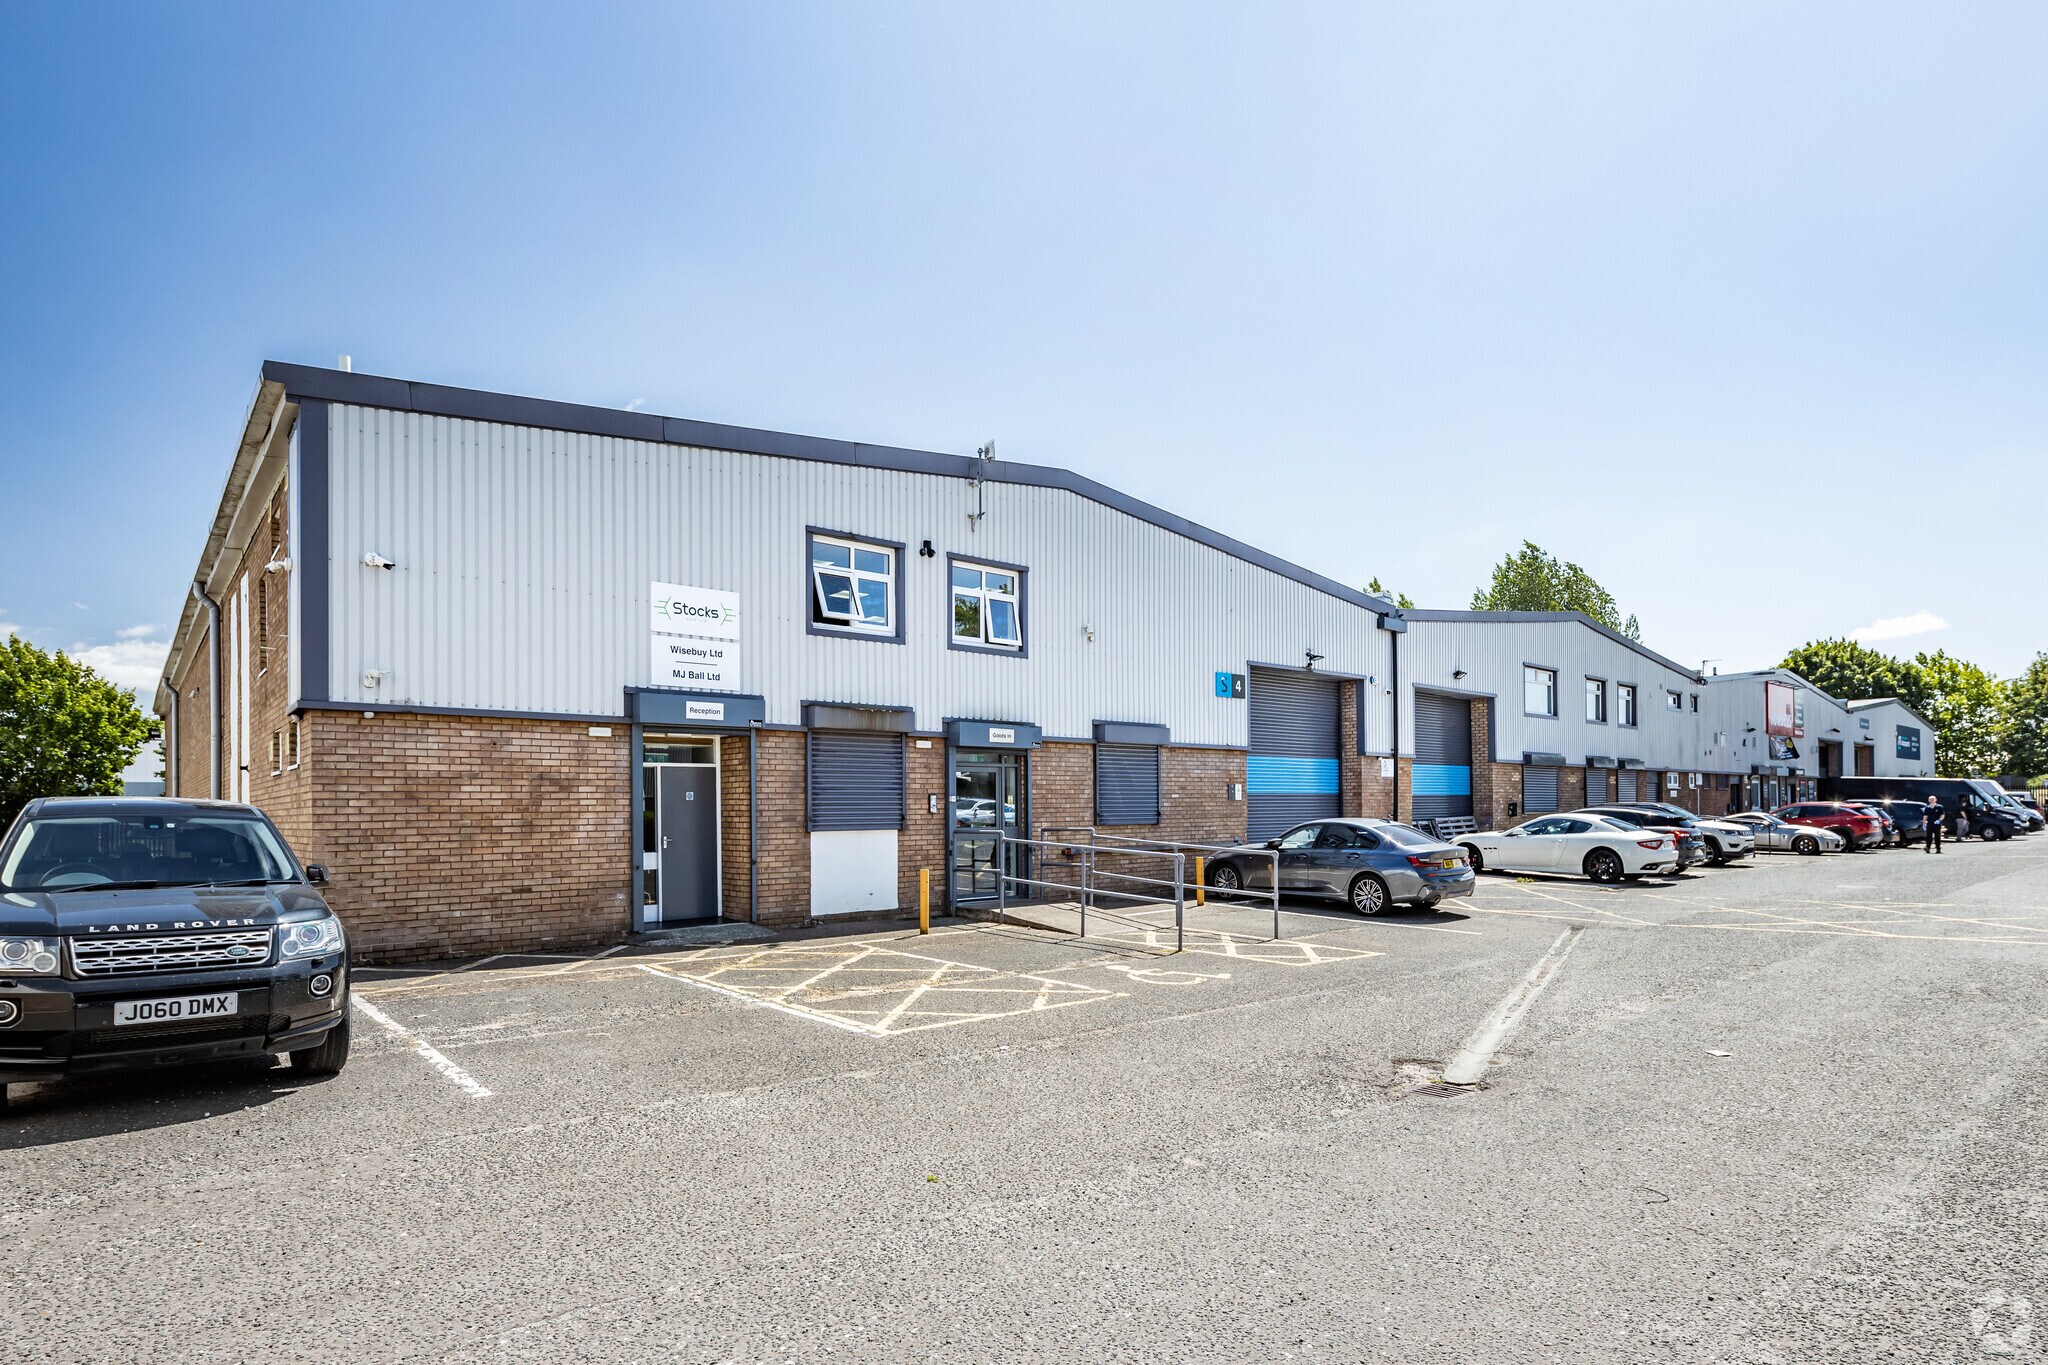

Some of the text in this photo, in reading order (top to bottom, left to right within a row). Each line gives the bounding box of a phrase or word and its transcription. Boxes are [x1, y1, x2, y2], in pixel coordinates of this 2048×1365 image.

[672, 602, 719, 619] Stocks
[670, 645, 723, 658] Wisebuy Ltd
[672, 669, 720, 681] MJ Ball Ltd
[1235, 680, 1242, 693] 4
[689, 706, 721, 715] Reception
[89, 918, 255, 933] LAND ROVER
[124, 996, 229, 1021] JO60 DMX
